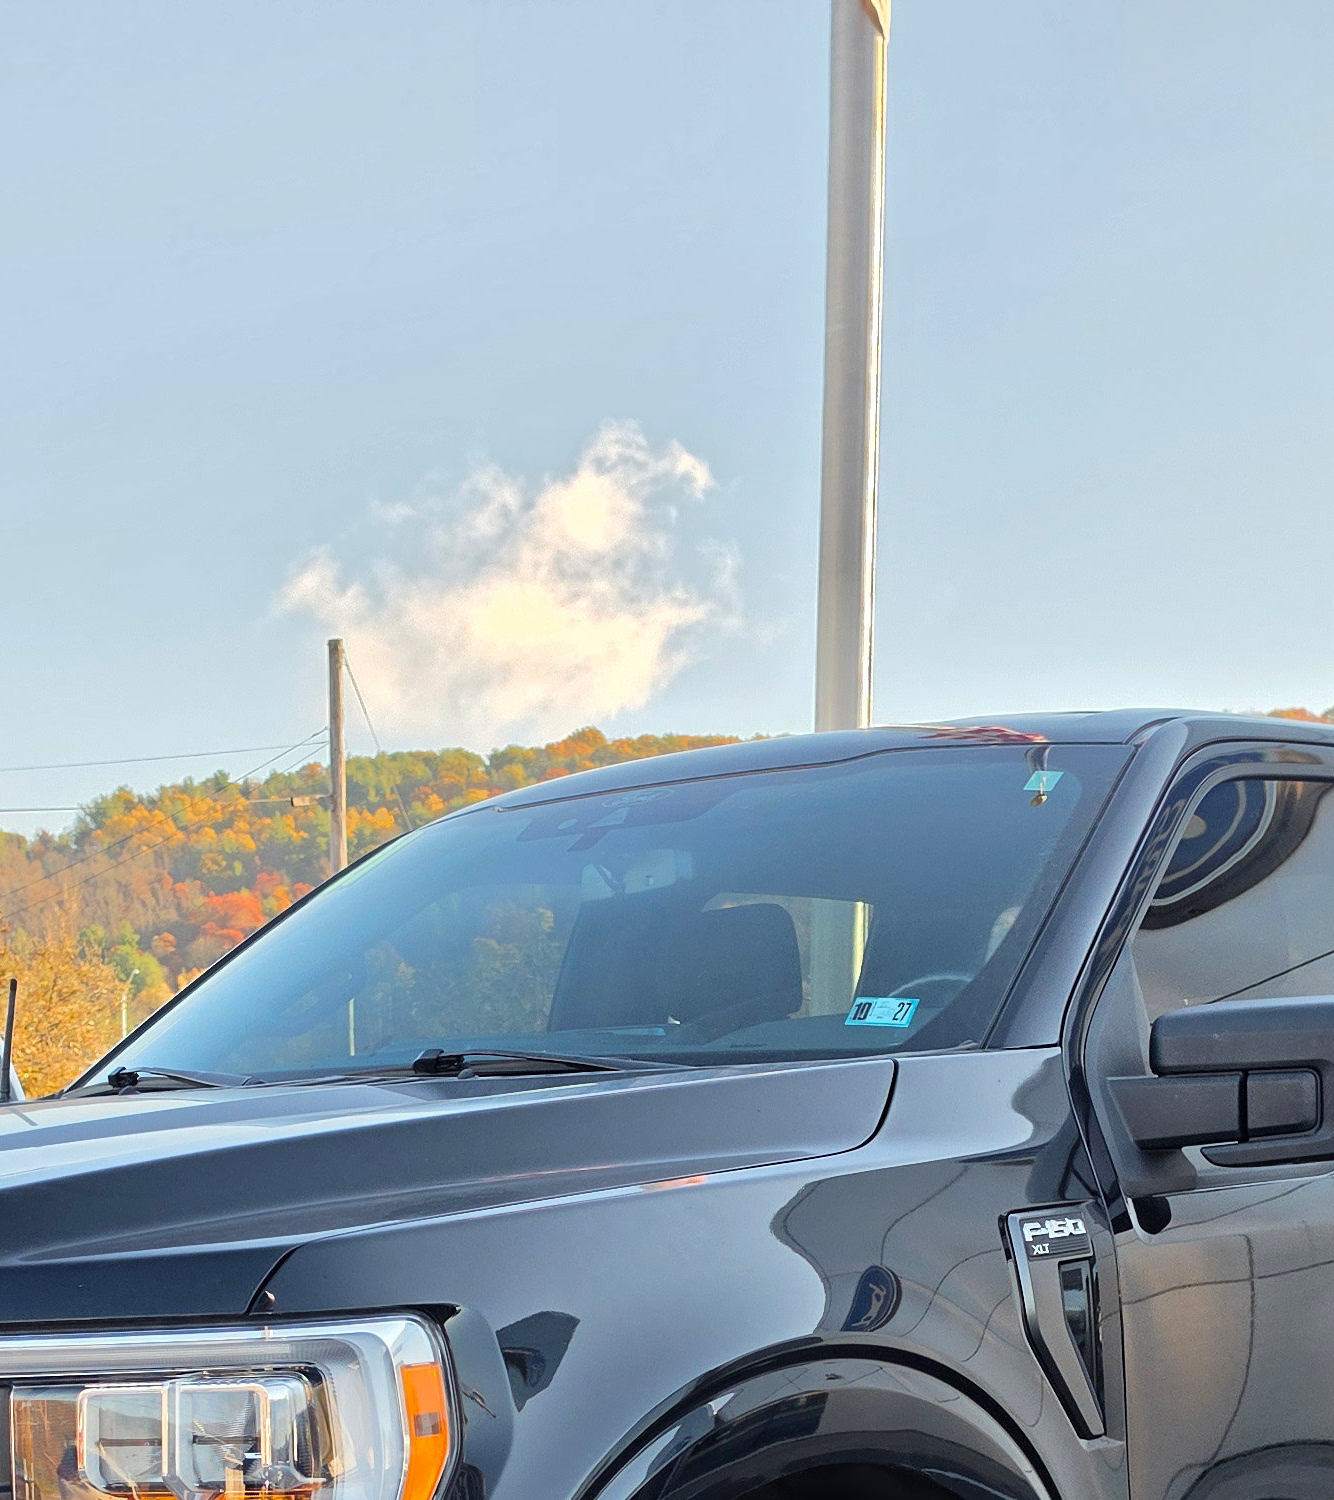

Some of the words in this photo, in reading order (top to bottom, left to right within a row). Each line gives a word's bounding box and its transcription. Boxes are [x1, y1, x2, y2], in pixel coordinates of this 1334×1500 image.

[852, 1002, 872, 1021] 10
[892, 1001, 912, 1021] 27
[1022, 1217, 1087, 1242] F-150
[1031, 1243, 1050, 1256] XLT
